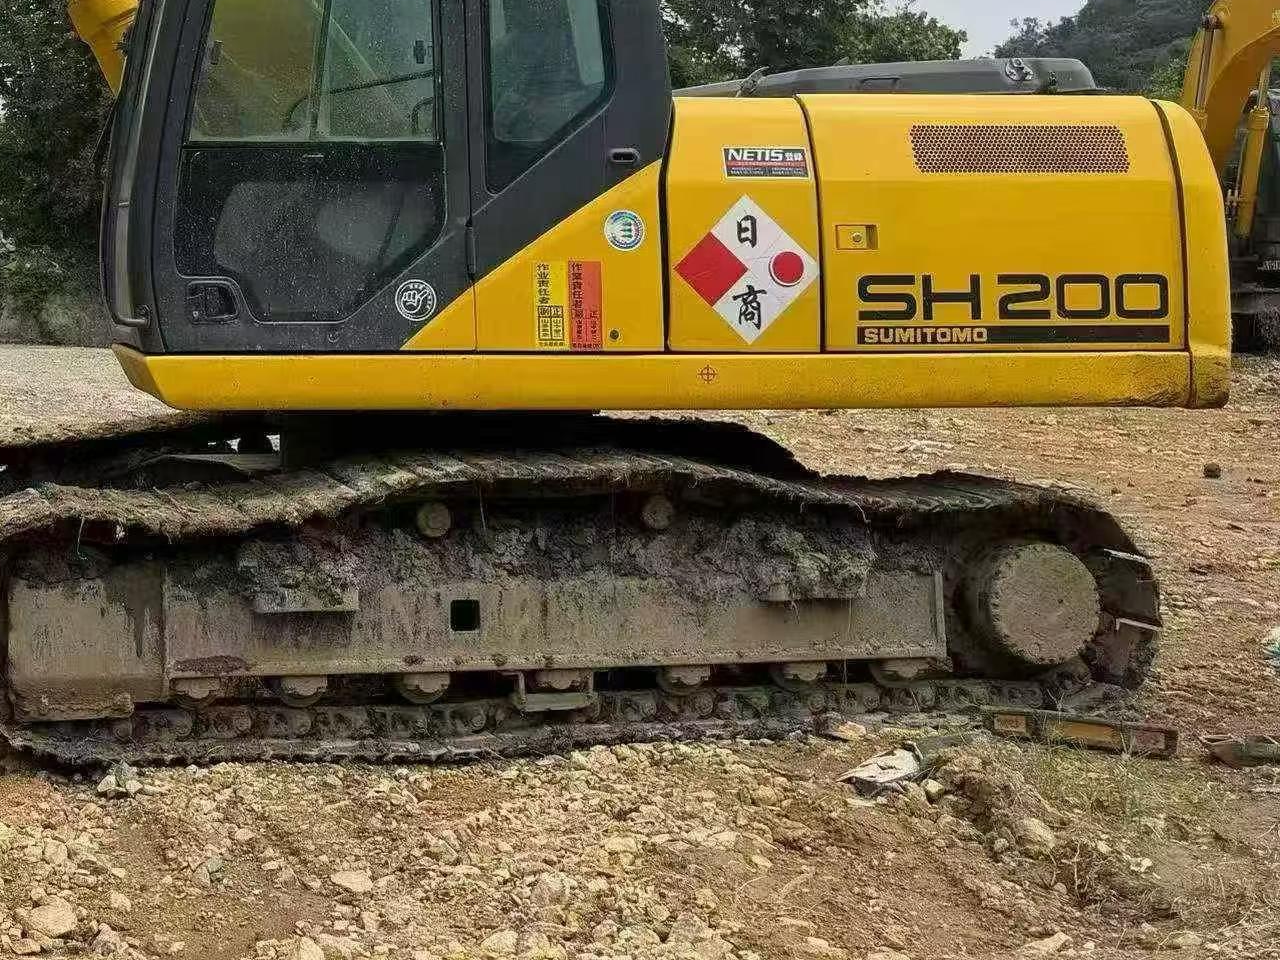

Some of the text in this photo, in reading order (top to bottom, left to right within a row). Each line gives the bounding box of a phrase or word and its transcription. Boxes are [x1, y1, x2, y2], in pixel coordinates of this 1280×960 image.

[728, 149, 783, 161] NETIS
[858, 273, 1168, 321] SH 200
[864, 326, 988, 344] SUMITOMO
